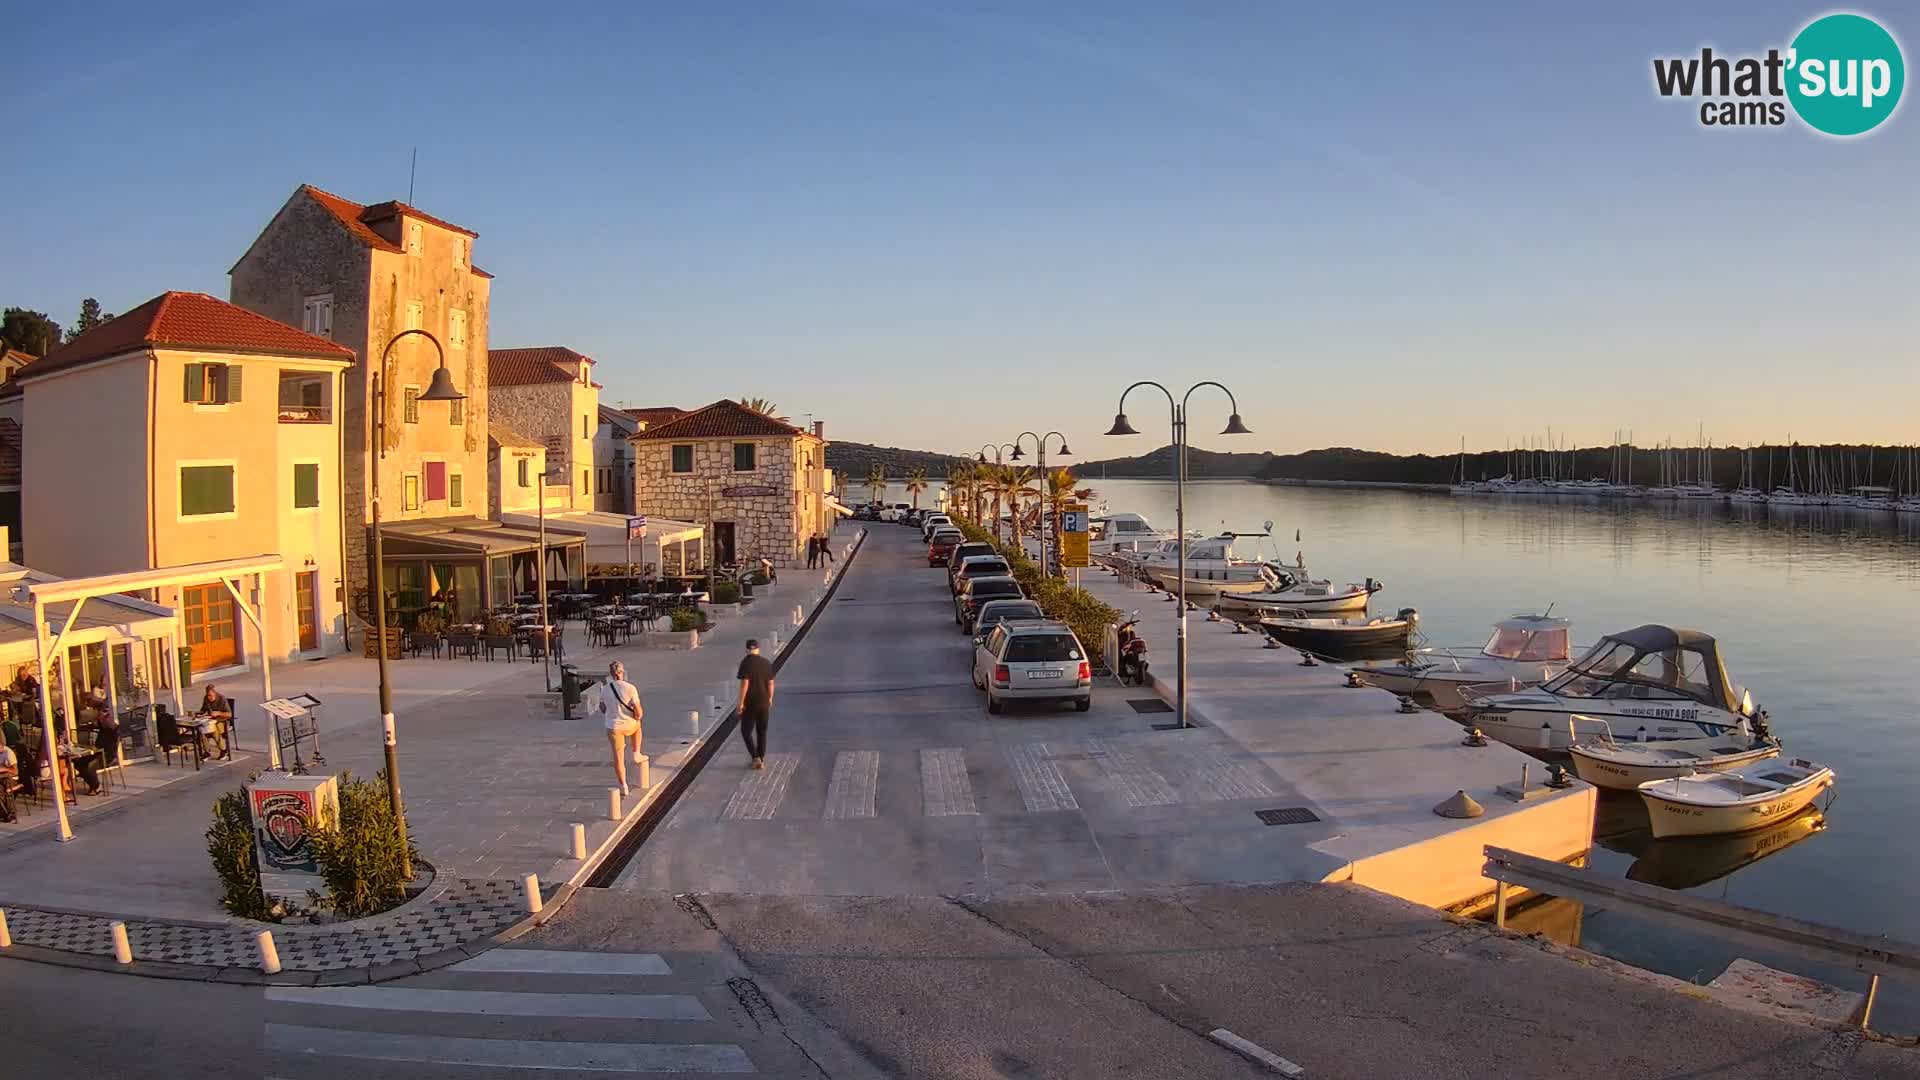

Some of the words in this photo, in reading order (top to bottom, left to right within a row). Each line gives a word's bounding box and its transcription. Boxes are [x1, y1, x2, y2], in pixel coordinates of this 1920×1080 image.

[1065, 514, 1076, 530] P
[1655, 708, 1673, 718] RENT
[1675, 709, 1680, 718] A
[1681, 709, 1699, 720] BOAT
